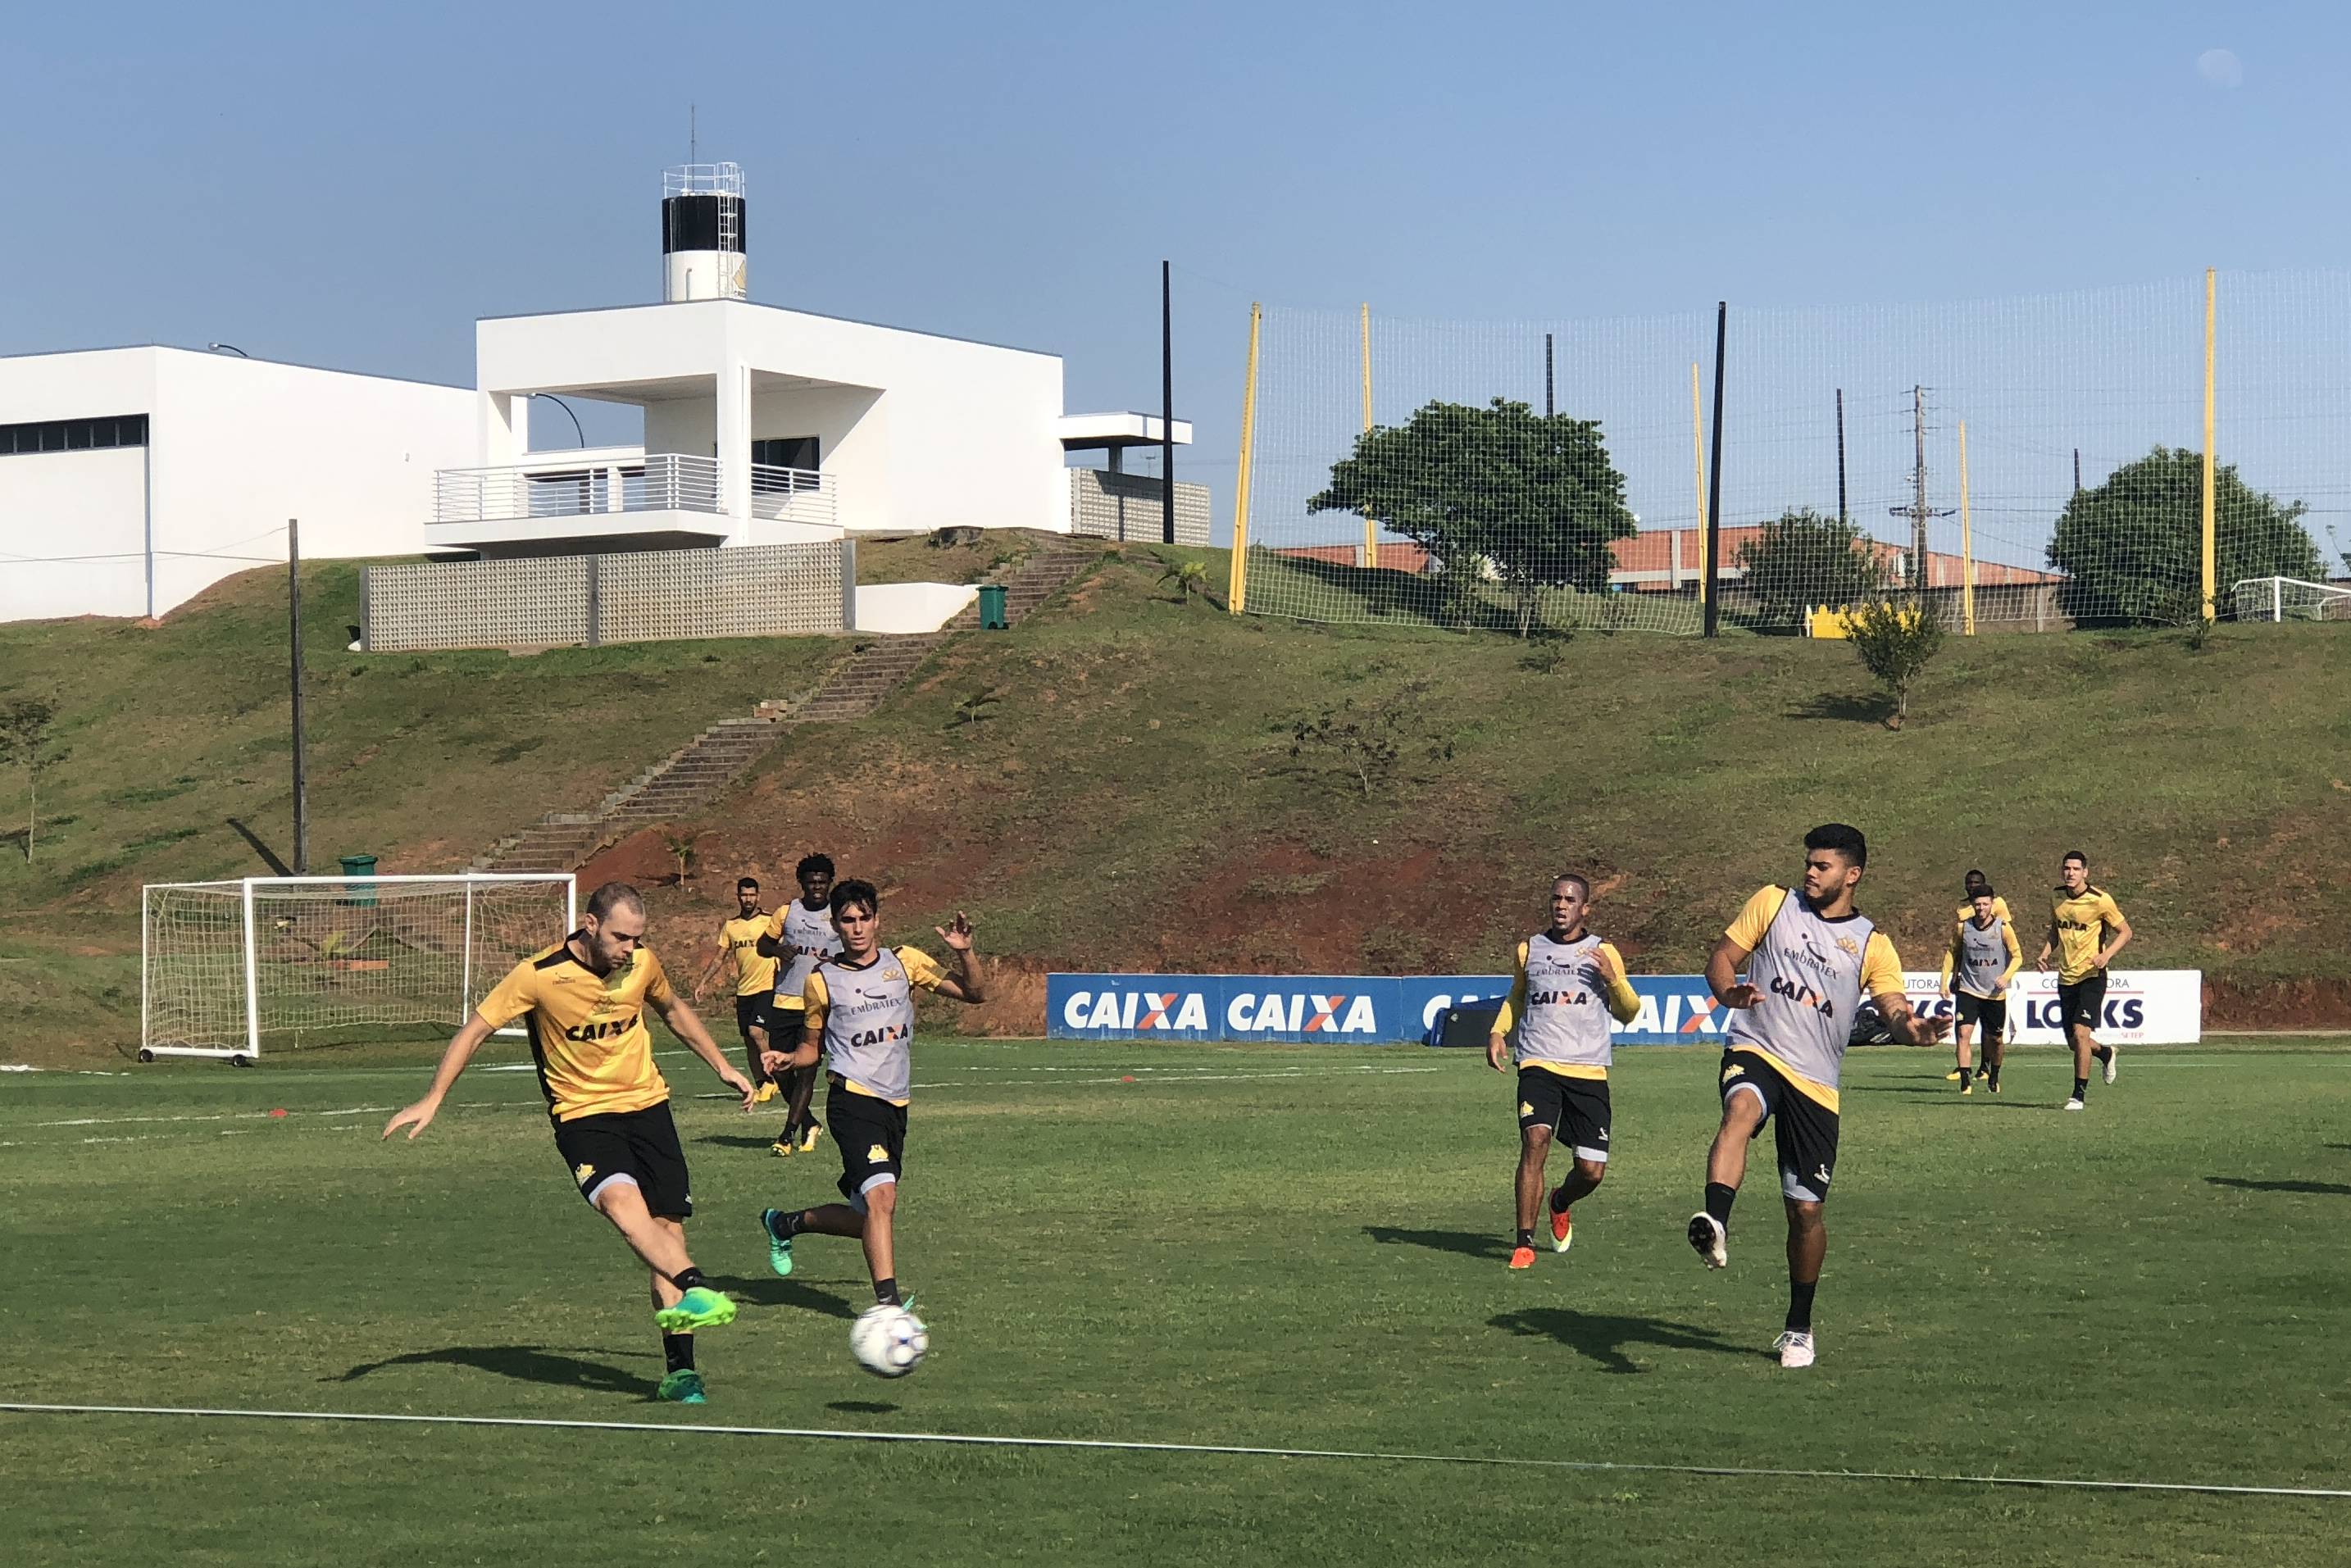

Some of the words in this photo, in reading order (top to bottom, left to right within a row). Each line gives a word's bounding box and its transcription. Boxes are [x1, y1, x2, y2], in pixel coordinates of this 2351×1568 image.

[797, 946, 828, 957] AIXA
[1064, 992, 1207, 1029] CAIXA
[1228, 993, 1376, 1033] CAIXA
[1532, 990, 1587, 1006] CAIXA
[1609, 994, 1735, 1034] AIX
[1771, 977, 1833, 1018] CAIXA
[851, 1023, 908, 1048] CAIXA
